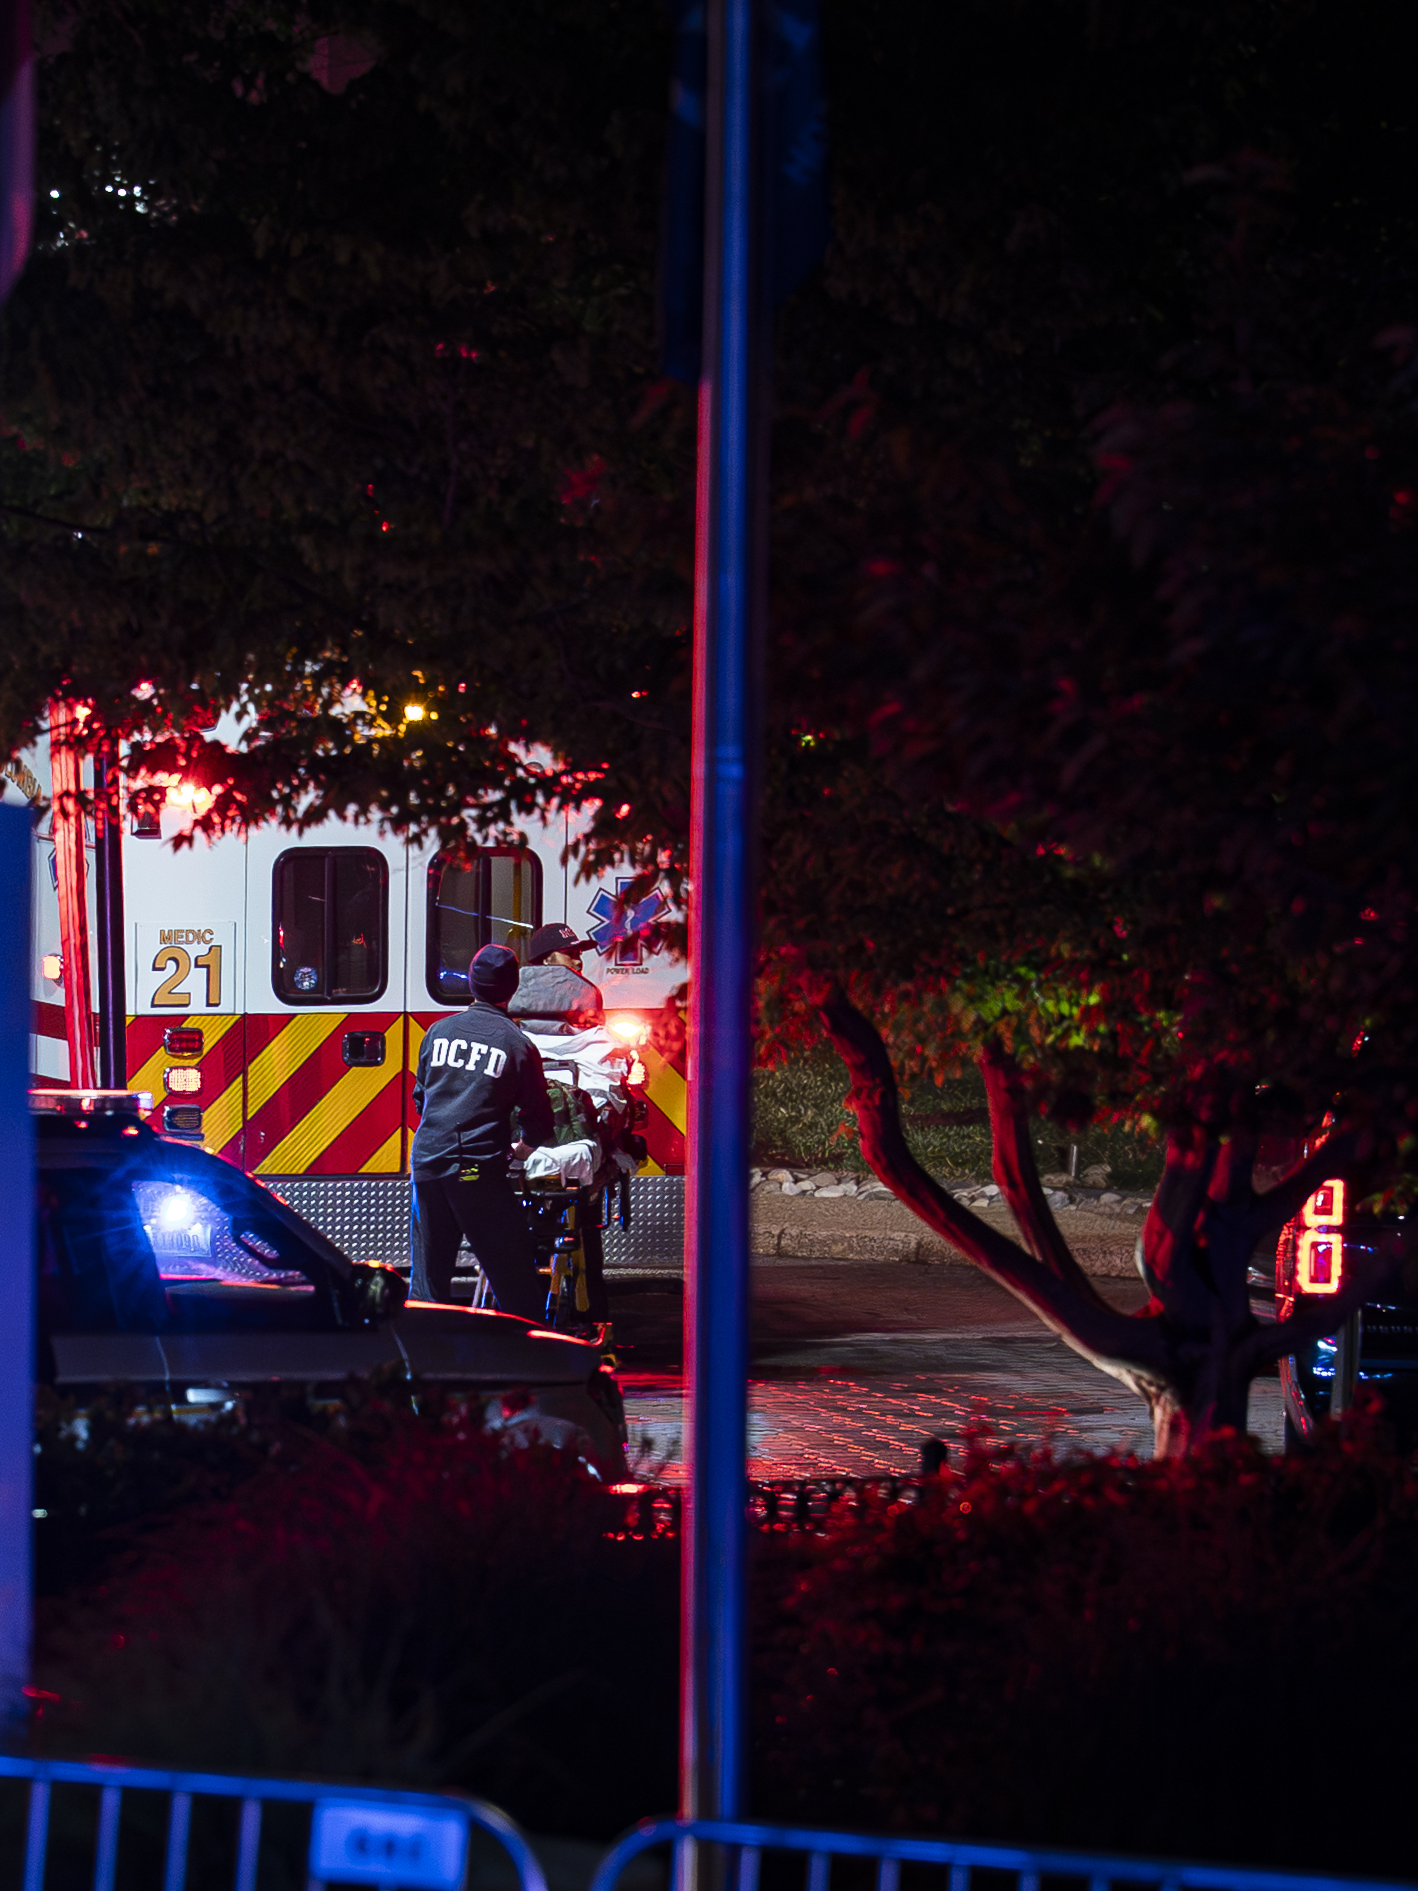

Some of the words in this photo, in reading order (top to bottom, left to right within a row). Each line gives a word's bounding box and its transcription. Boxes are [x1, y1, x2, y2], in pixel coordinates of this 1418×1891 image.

[159, 928, 215, 945] MEDIC
[150, 945, 222, 1008] 21
[632, 967, 650, 975] LOAD
[430, 1037, 507, 1079] DCFD
